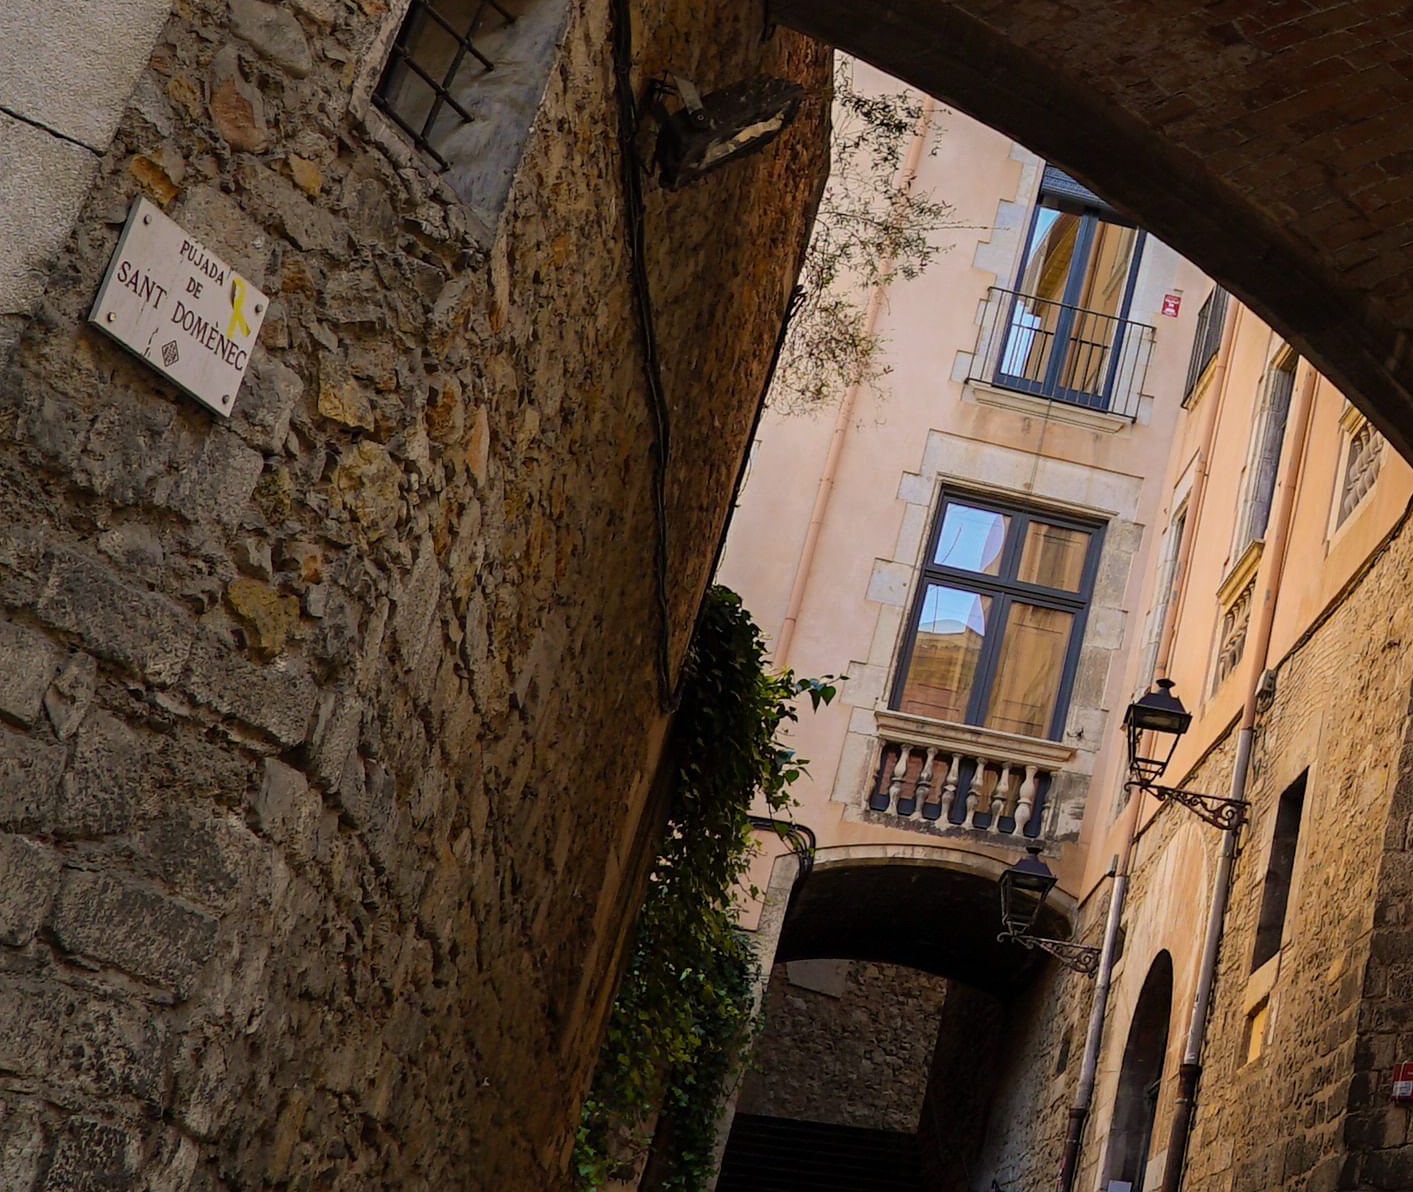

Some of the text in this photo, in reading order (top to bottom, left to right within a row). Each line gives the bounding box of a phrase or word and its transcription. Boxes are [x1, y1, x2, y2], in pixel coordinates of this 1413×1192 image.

[180, 240, 225, 286] PUJADA
[186, 276, 204, 299] DE
[117, 261, 247, 371] SANT DOMÈNEC
